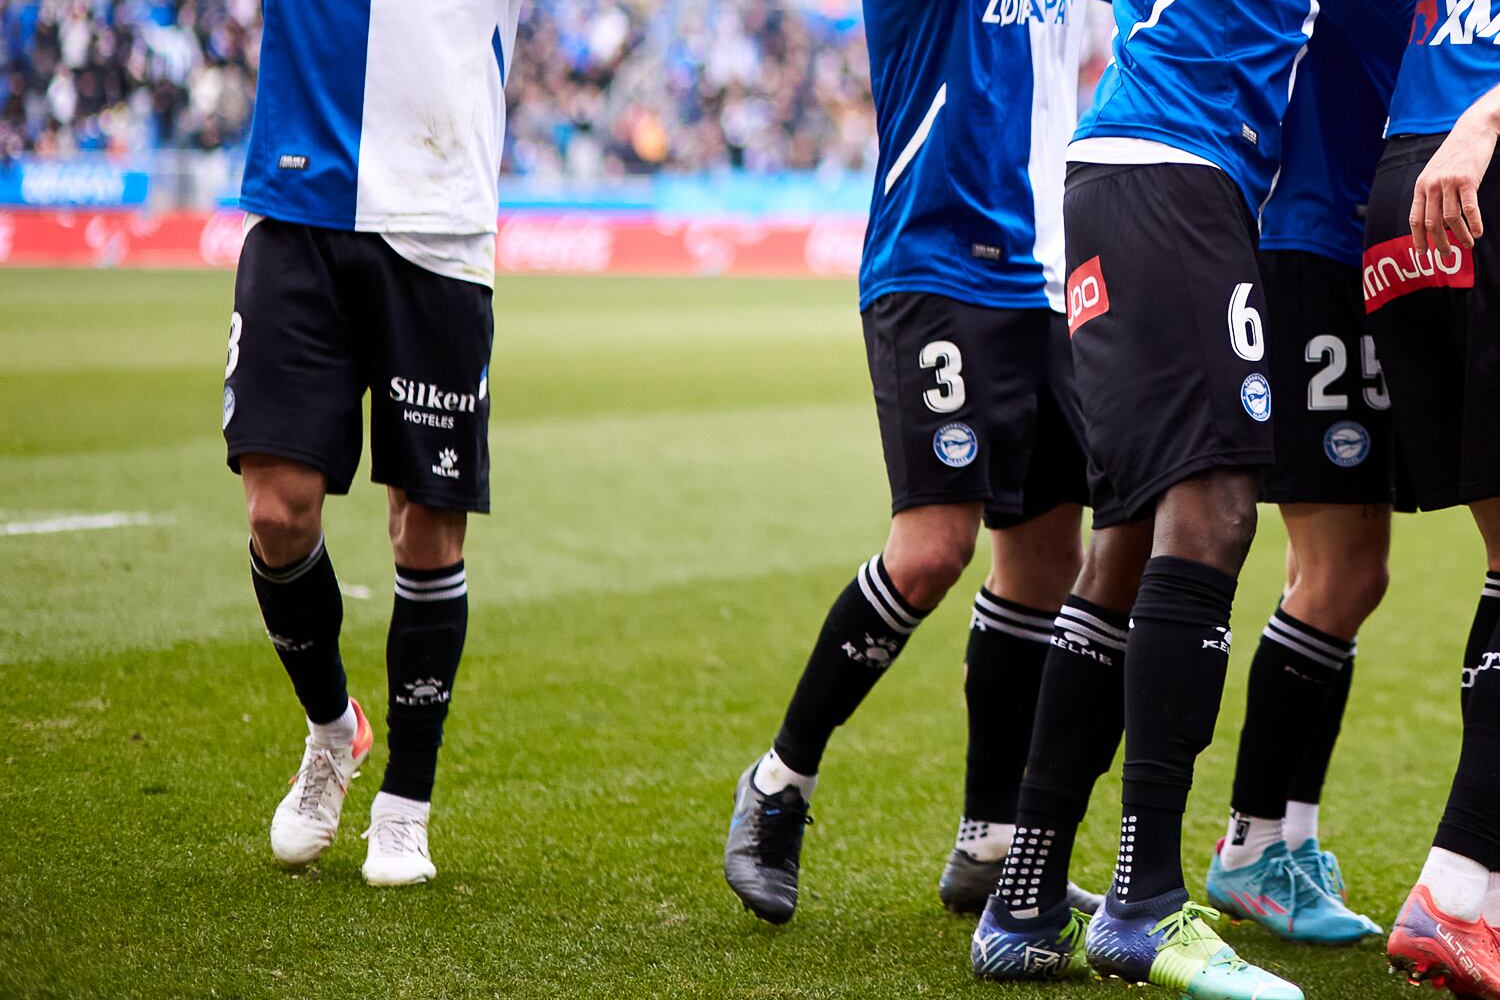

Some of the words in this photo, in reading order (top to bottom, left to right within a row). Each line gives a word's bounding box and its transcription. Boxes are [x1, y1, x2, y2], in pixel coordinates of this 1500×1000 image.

[1228, 283, 1265, 362] 6
[389, 376, 476, 413] Silken
[919, 341, 966, 413] 3
[1305, 334, 1392, 411] 25
[403, 409, 455, 429] HOTELES
[1436, 923, 1483, 982] ULTRA
